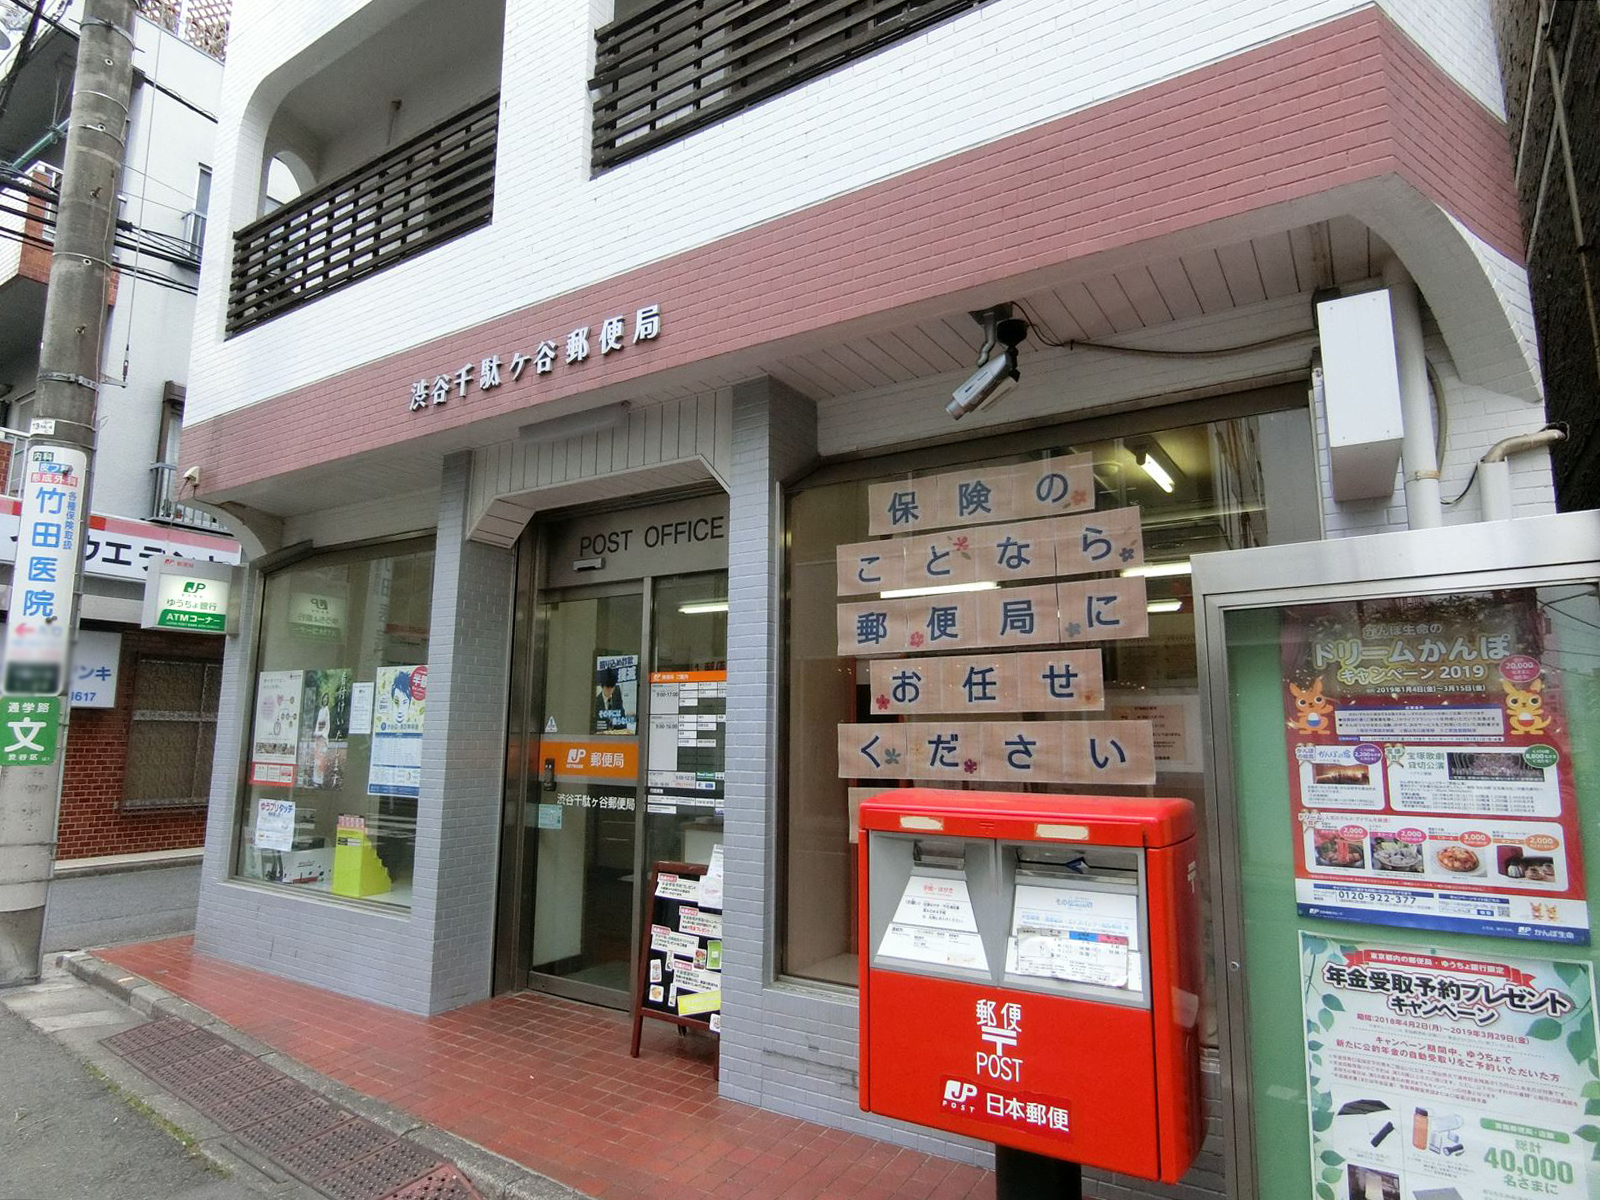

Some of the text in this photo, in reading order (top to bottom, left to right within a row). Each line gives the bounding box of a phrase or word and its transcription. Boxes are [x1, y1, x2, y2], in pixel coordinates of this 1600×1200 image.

[888, 473, 1069, 526] 保険の
[579, 516, 724, 556] POST OFFICE
[23, 487, 66, 617] 竹田医院
[858, 527, 1113, 583] ことなら
[166, 613, 221, 624] ATMコーナー
[167, 599, 217, 611] ゆうちょ銀行
[857, 595, 1120, 645] 郵便局に
[1314, 634, 1511, 669] ドリームかんぽ
[891, 664, 1078, 703] お任せ
[1340, 664, 1485, 683] キャンペーン 2019
[8, 702, 49, 713] 通学路
[4, 717, 47, 753] 文
[591, 752, 624, 769] 郵便局
[860, 733, 1126, 770] ください
[1406, 752, 1445, 761] 宝塚歌劇
[1408, 761, 1445, 770] 貸切公演
[1338, 891, 1416, 905] 0120-922-377
[1326, 964, 1569, 1014] 年金受取予約プレゼント
[975, 999, 1022, 1032] 郵便
[1391, 995, 1496, 1024] キャンペーン
[1376, 1036, 1512, 1065] キャンペーン期間中、ゆうちょで
[976, 1052, 1024, 1082] POST
[942, 1100, 975, 1113] POST
[944, 1080, 1069, 1132] JP 日本郵便
[1483, 1146, 1574, 1185] 40,000
[1503, 1174, 1559, 1196] 名さまに
